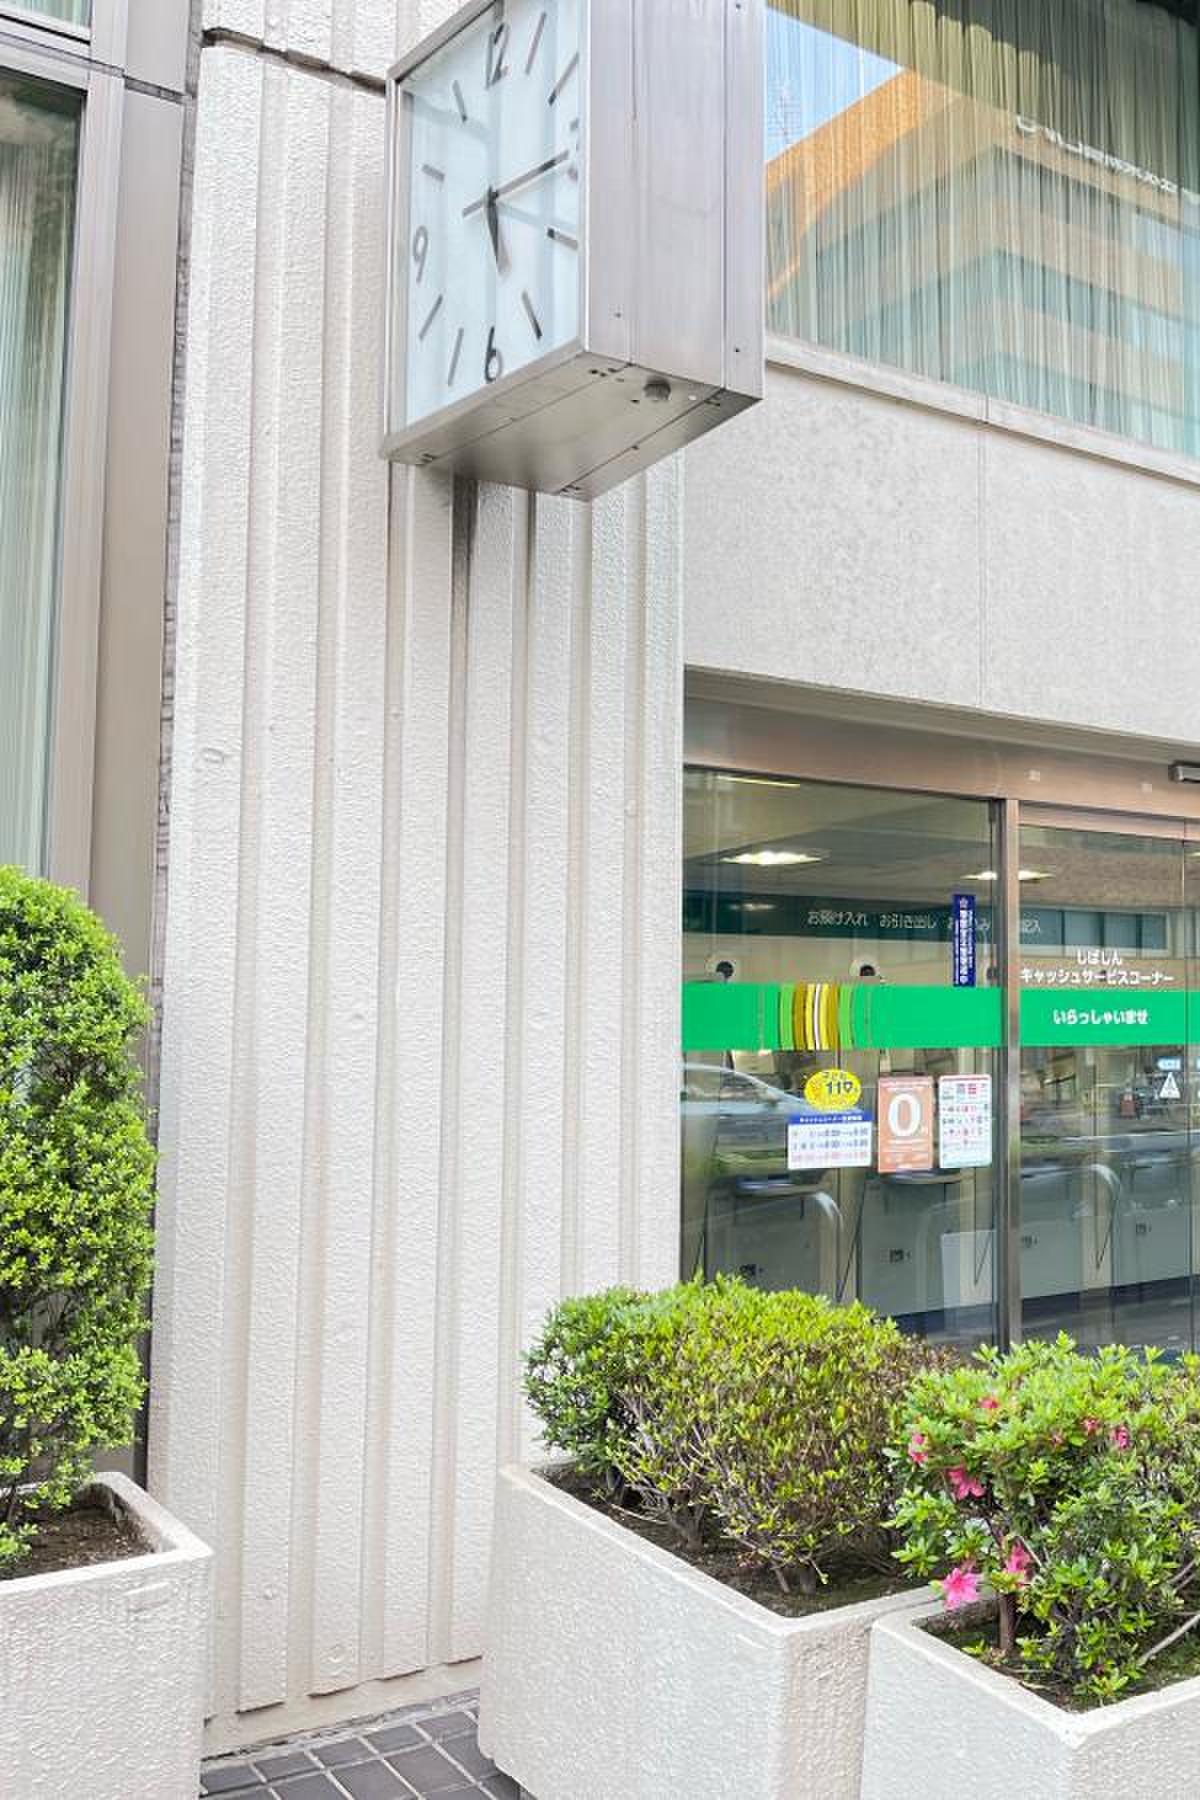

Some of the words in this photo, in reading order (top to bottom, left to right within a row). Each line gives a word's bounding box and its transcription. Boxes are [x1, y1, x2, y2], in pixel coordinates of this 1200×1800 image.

[412, 225, 429, 284] 9
[485, 326, 503, 383] 6
[1076, 949, 1123, 966] しばしん
[1020, 967, 1175, 985] キャッシュサービスコーナー
[1053, 1009, 1149, 1025] いらっしゃいませ
[888, 1093, 921, 1137] 0
